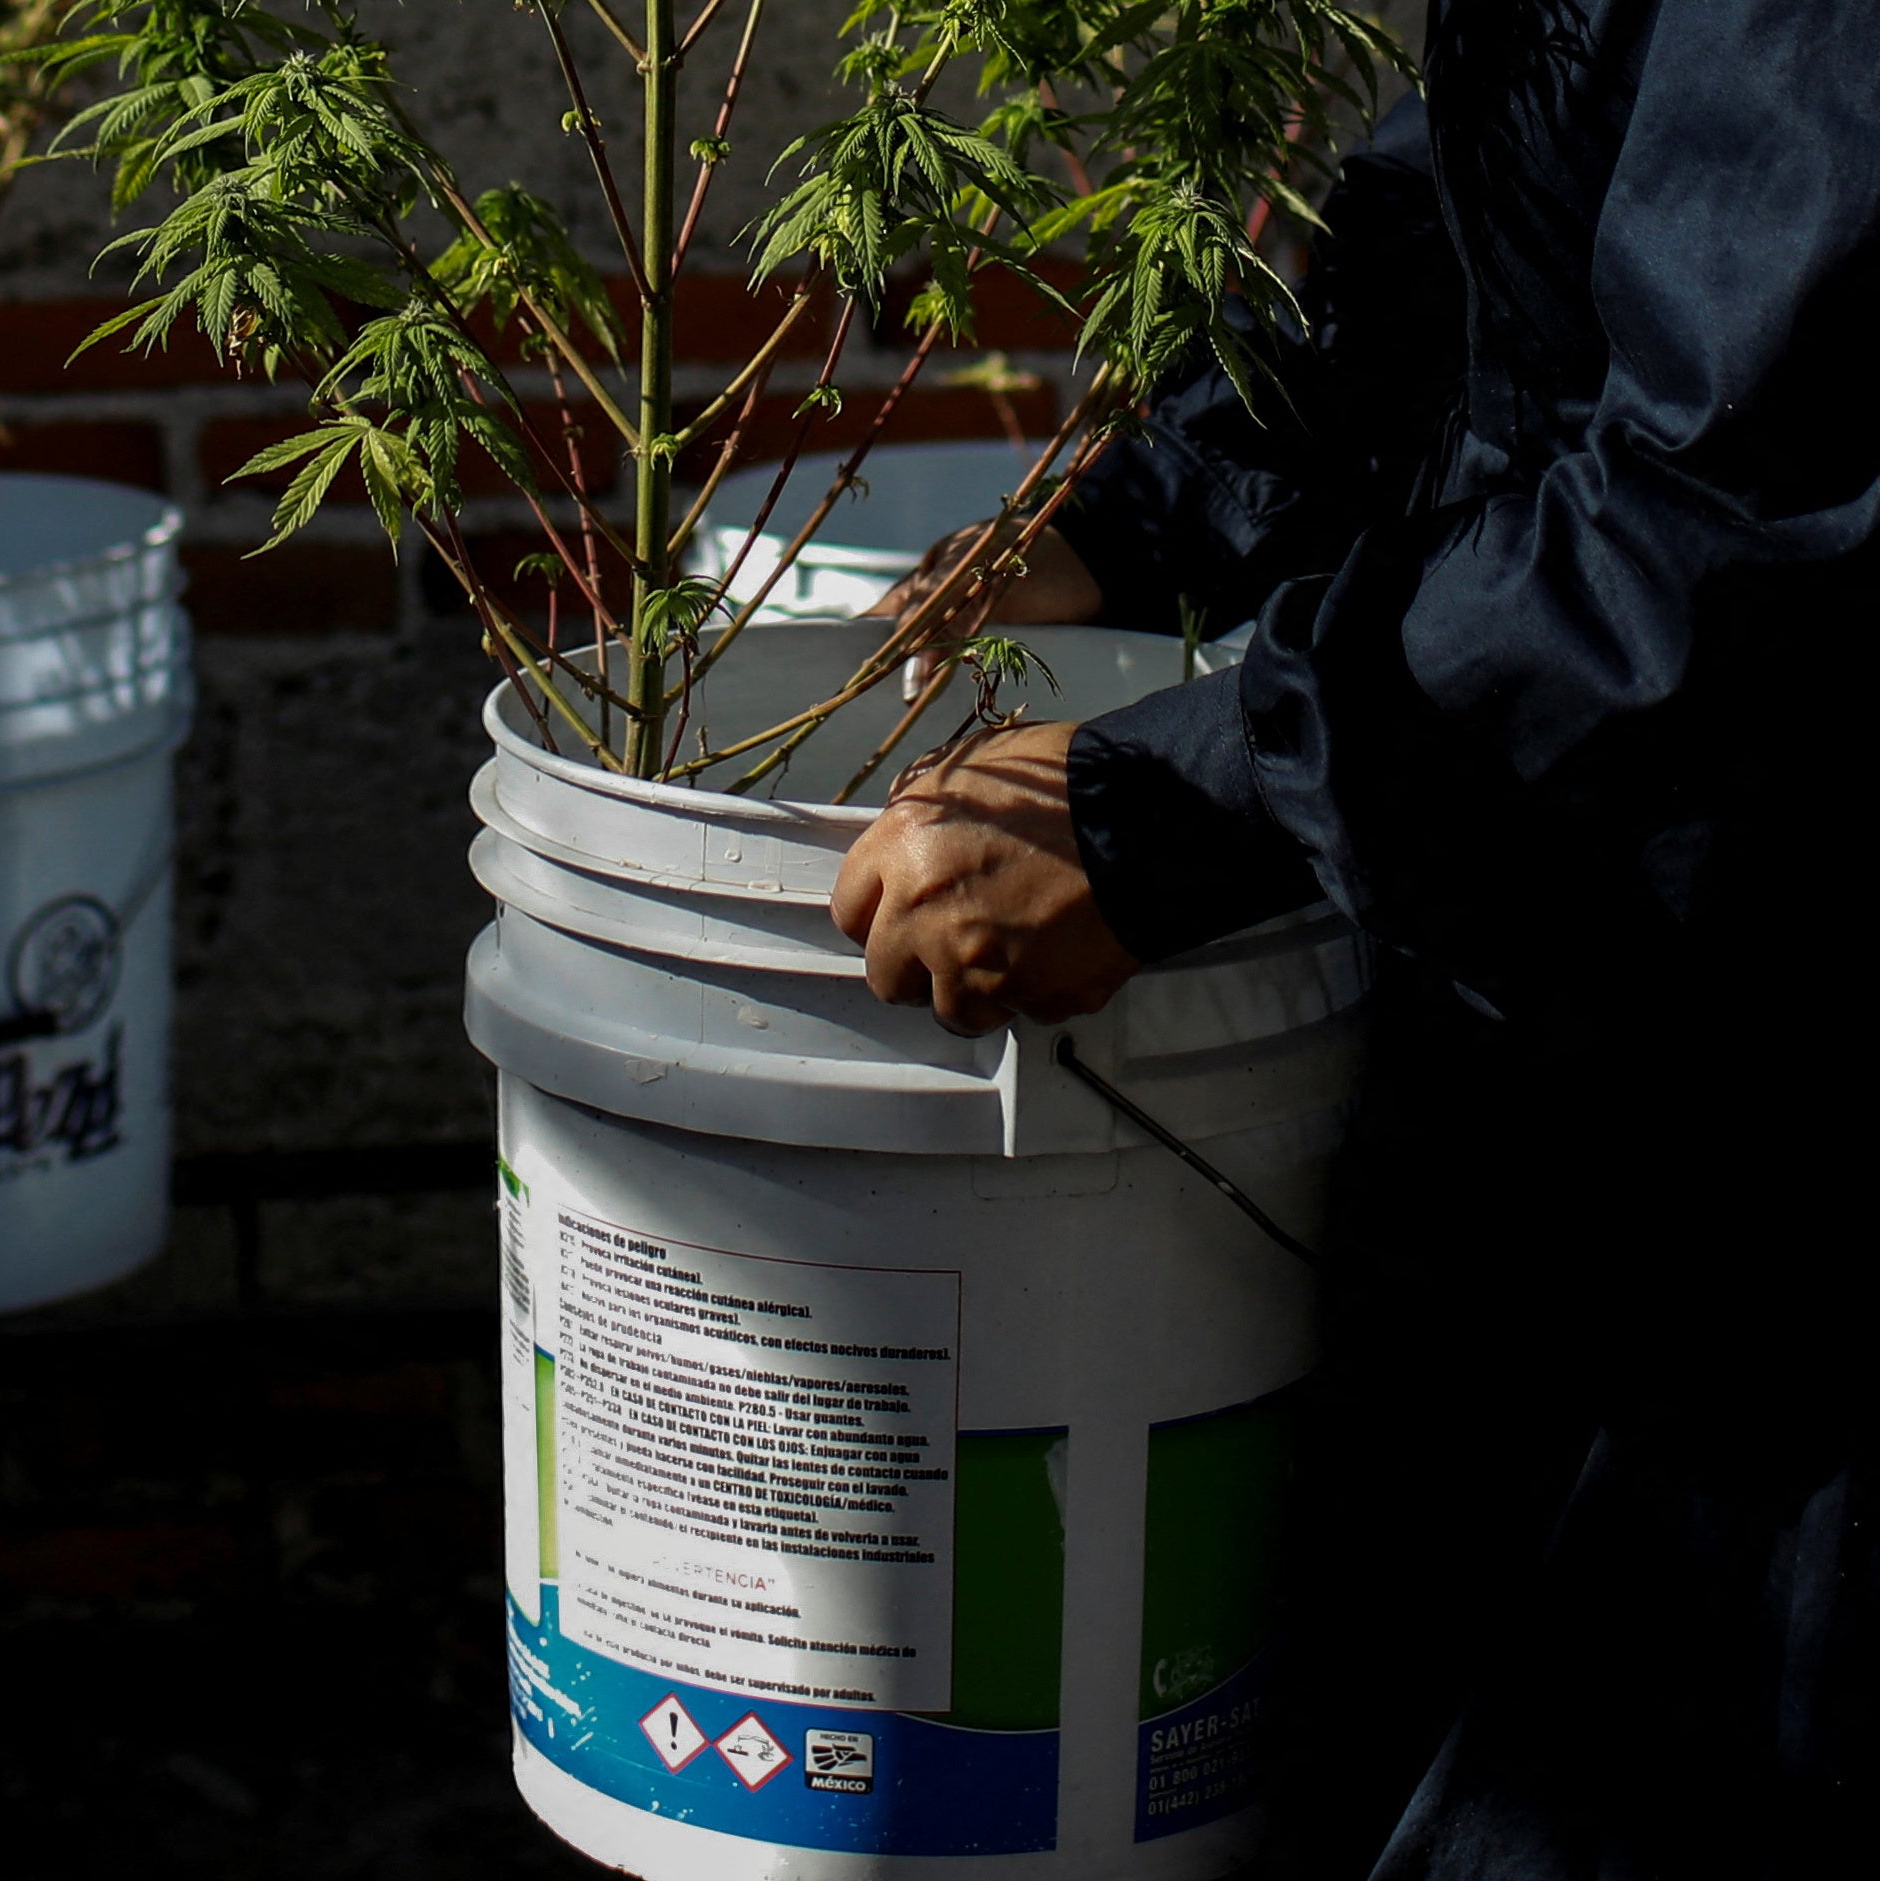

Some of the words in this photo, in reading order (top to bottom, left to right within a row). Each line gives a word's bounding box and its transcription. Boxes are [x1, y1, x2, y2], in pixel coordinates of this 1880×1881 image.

[613, 1233, 626, 1249] de
[628, 1239, 666, 1260] peligro
[614, 1252, 655, 1274] irritación
[645, 1279, 662, 1293] una
[664, 1284, 709, 1304] reacción
[710, 1294, 755, 1312] cutánea
[653, 1298, 696, 1317] oculares
[611, 1321, 662, 1345] prudencia
[644, 1313, 701, 1335] organismos
[761, 1335, 782, 1350] con
[784, 1339, 828, 1355] efectos
[830, 1344, 878, 1358] nocivos
[879, 1346, 951, 1361] duraderos).
[652, 1368, 716, 1391] contaminada
[719, 1382, 732, 1394] no
[734, 1384, 762, 1399] debe
[764, 1389, 790, 1403] salir
[792, 1392, 811, 1406] del
[813, 1393, 845, 1410] lugar
[846, 1397, 862, 1411] de
[863, 1398, 911, 1414] trabajo.
[653, 1384, 682, 1400] medio
[738, 1401, 776, 1418] P280.5
[785, 1407, 811, 1423] Usar
[814, 1412, 865, 1428] guantes.
[622, 1389, 644, 1406] CASO
[646, 1397, 656, 1411] DE
[658, 1400, 707, 1422] CONTACTO
[709, 1412, 730, 1427] CON
[733, 1416, 744, 1430] LA
[773, 1423, 804, 1438] Lavar
[805, 1428, 828, 1441] con
[830, 1430, 895, 1446] abundante
[896, 1435, 930, 1450] agua.
[622, 1424, 656, 1443] durante
[658, 1435, 687, 1452] varios
[689, 1443, 734, 1462] minutos.
[736, 1450, 770, 1467] Quitar
[772, 1456, 789, 1470] las
[791, 1458, 828, 1475] lentes
[830, 1463, 845, 1477] de
[847, 1466, 901, 1481] contacto
[903, 1468, 949, 1481] cuando
[641, 1412, 664, 1429] CASO
[666, 1418, 677, 1433] DE
[679, 1422, 730, 1444] CONTACTO
[733, 1434, 754, 1448] CON
[757, 1437, 776, 1452] LOS
[778, 1441, 808, 1456] OJOS:
[810, 1444, 863, 1461] Enjuagar
[864, 1450, 888, 1463] con
[889, 1451, 920, 1466] agua
[655, 1450, 694, 1470] hacerse
[696, 1461, 715, 1474] con
[769, 1473, 826, 1491] Proseguir
[827, 1481, 850, 1497] con
[852, 1481, 864, 1495] el
[865, 1482, 910, 1497] lavado.
[698, 1478, 711, 1490] un
[713, 1479, 752, 1499] CENTRO
[755, 1486, 768, 1501] DE
[723, 1500, 736, 1512] en
[738, 1502, 762, 1517] esta
[690, 1527, 743, 1546] recipiente
[745, 1537, 759, 1549] en
[761, 1537, 778, 1552] las
[781, 1541, 860, 1561] instalaciones
[862, 1548, 935, 1564] industriales
[740, 1518, 778, 1535] lavarla
[780, 1525, 812, 1540] antes
[814, 1528, 829, 1542] de
[831, 1531, 879, 1546] volverla
[881, 1534, 889, 1547] a
[692, 1590, 728, 1606] durante
[731, 1598, 742, 1609] su
[745, 1601, 802, 1619] aplicación.
[719, 1627, 728, 1637] el
[768, 1634, 808, 1650] Solicite
[809, 1641, 857, 1655] atención
[901, 1645, 917, 1659] de
[748, 1678, 811, 1697] supervisado
[813, 1687, 831, 1699] por
[811, 1776, 867, 1792] MÉXICO
